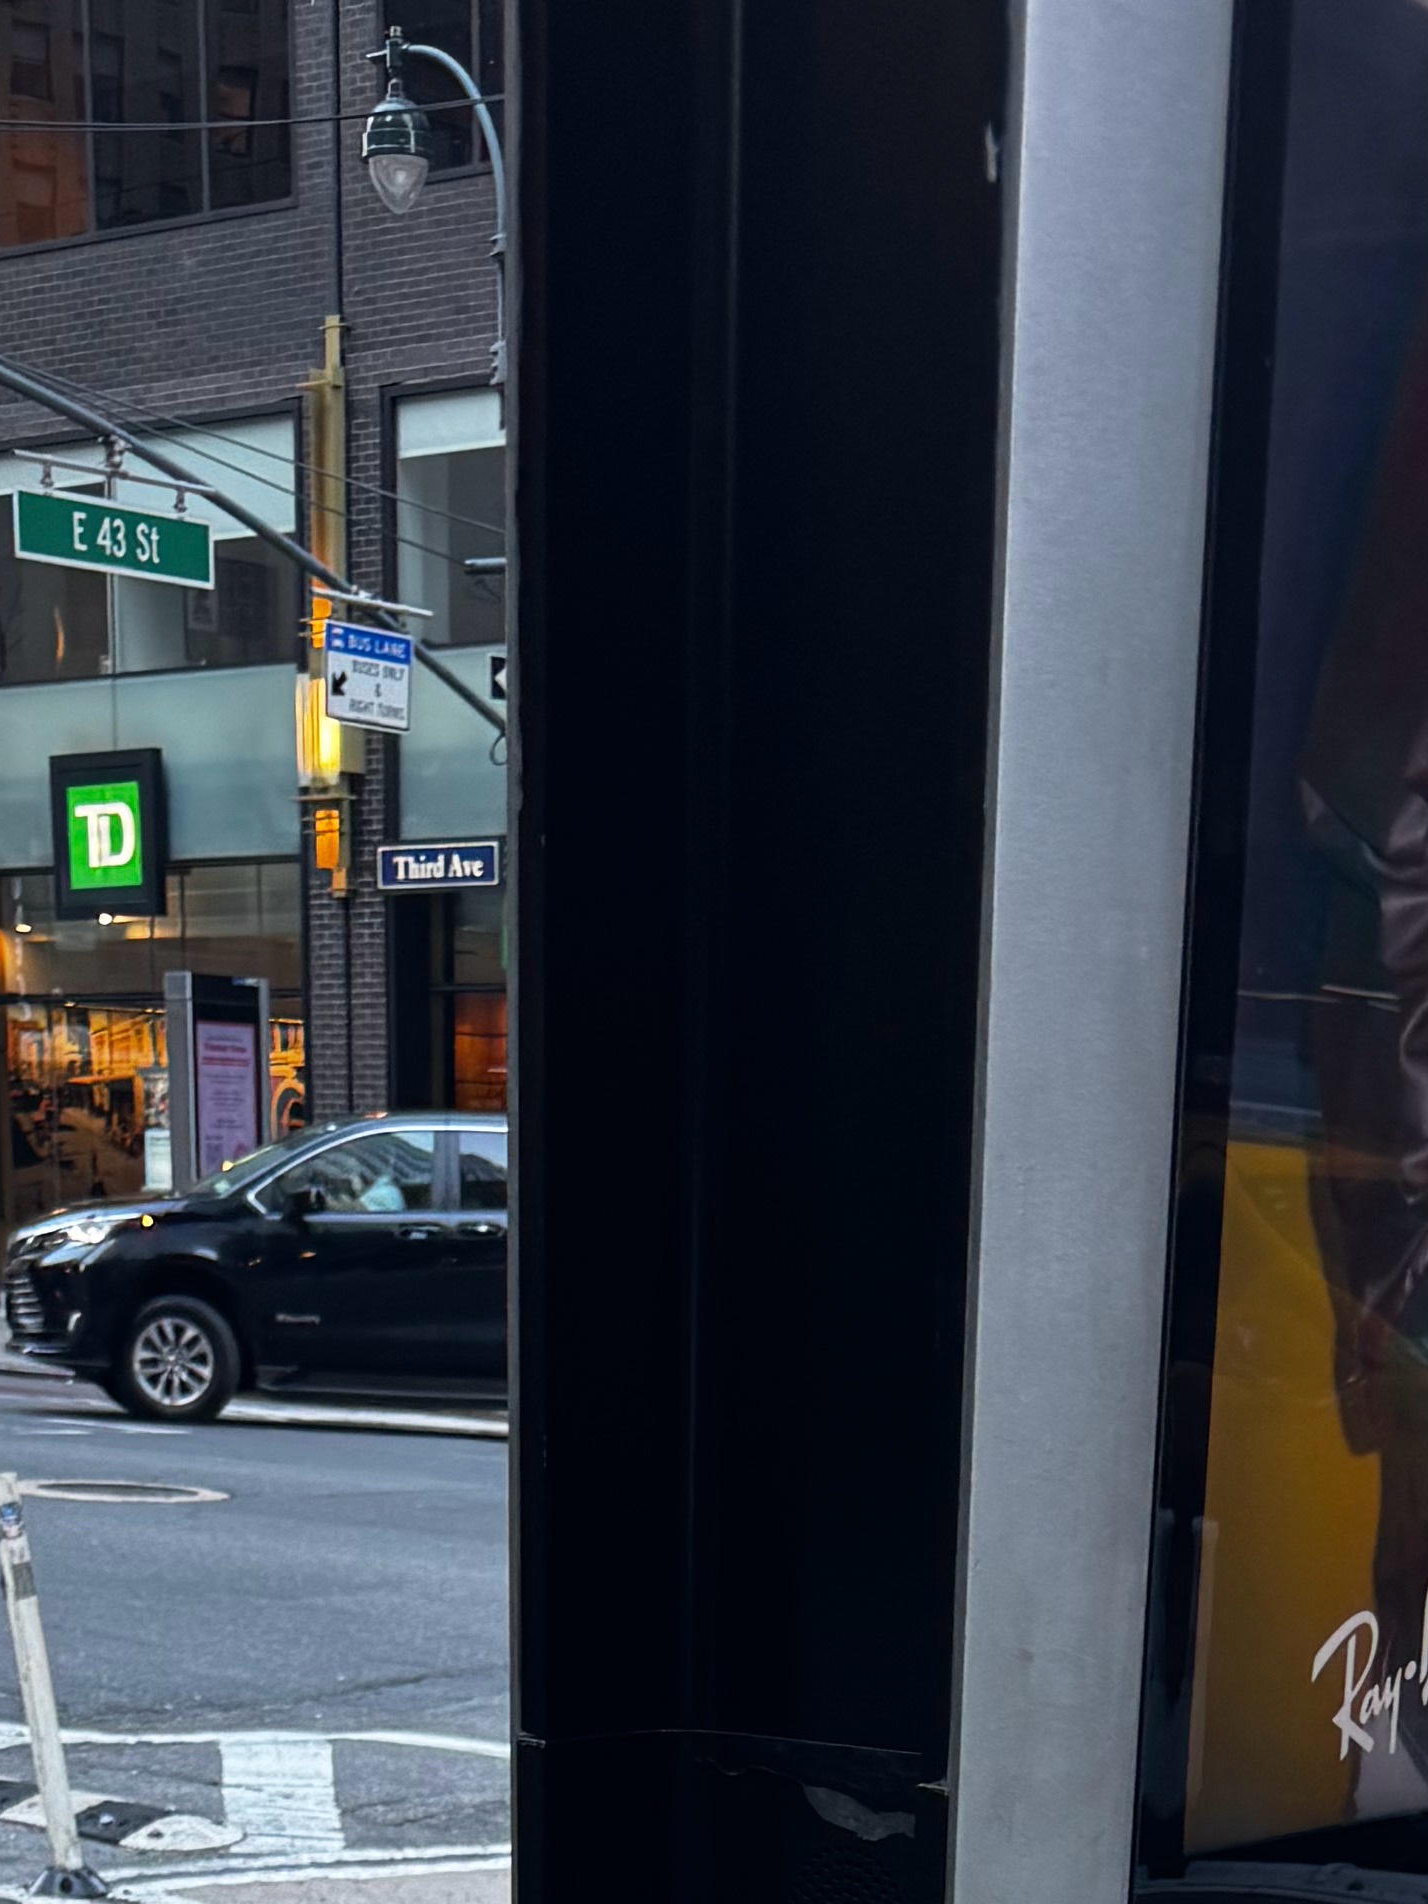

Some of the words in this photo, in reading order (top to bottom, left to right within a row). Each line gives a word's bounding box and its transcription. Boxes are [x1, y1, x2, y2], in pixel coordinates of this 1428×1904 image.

[72, 511, 88, 551] E
[96, 516, 126, 558] 43
[136, 522, 160, 564] St
[347, 634, 372, 653] BUS
[74, 801, 136, 868] TD
[393, 852, 445, 880] Third
[448, 849, 484, 878] Ave
